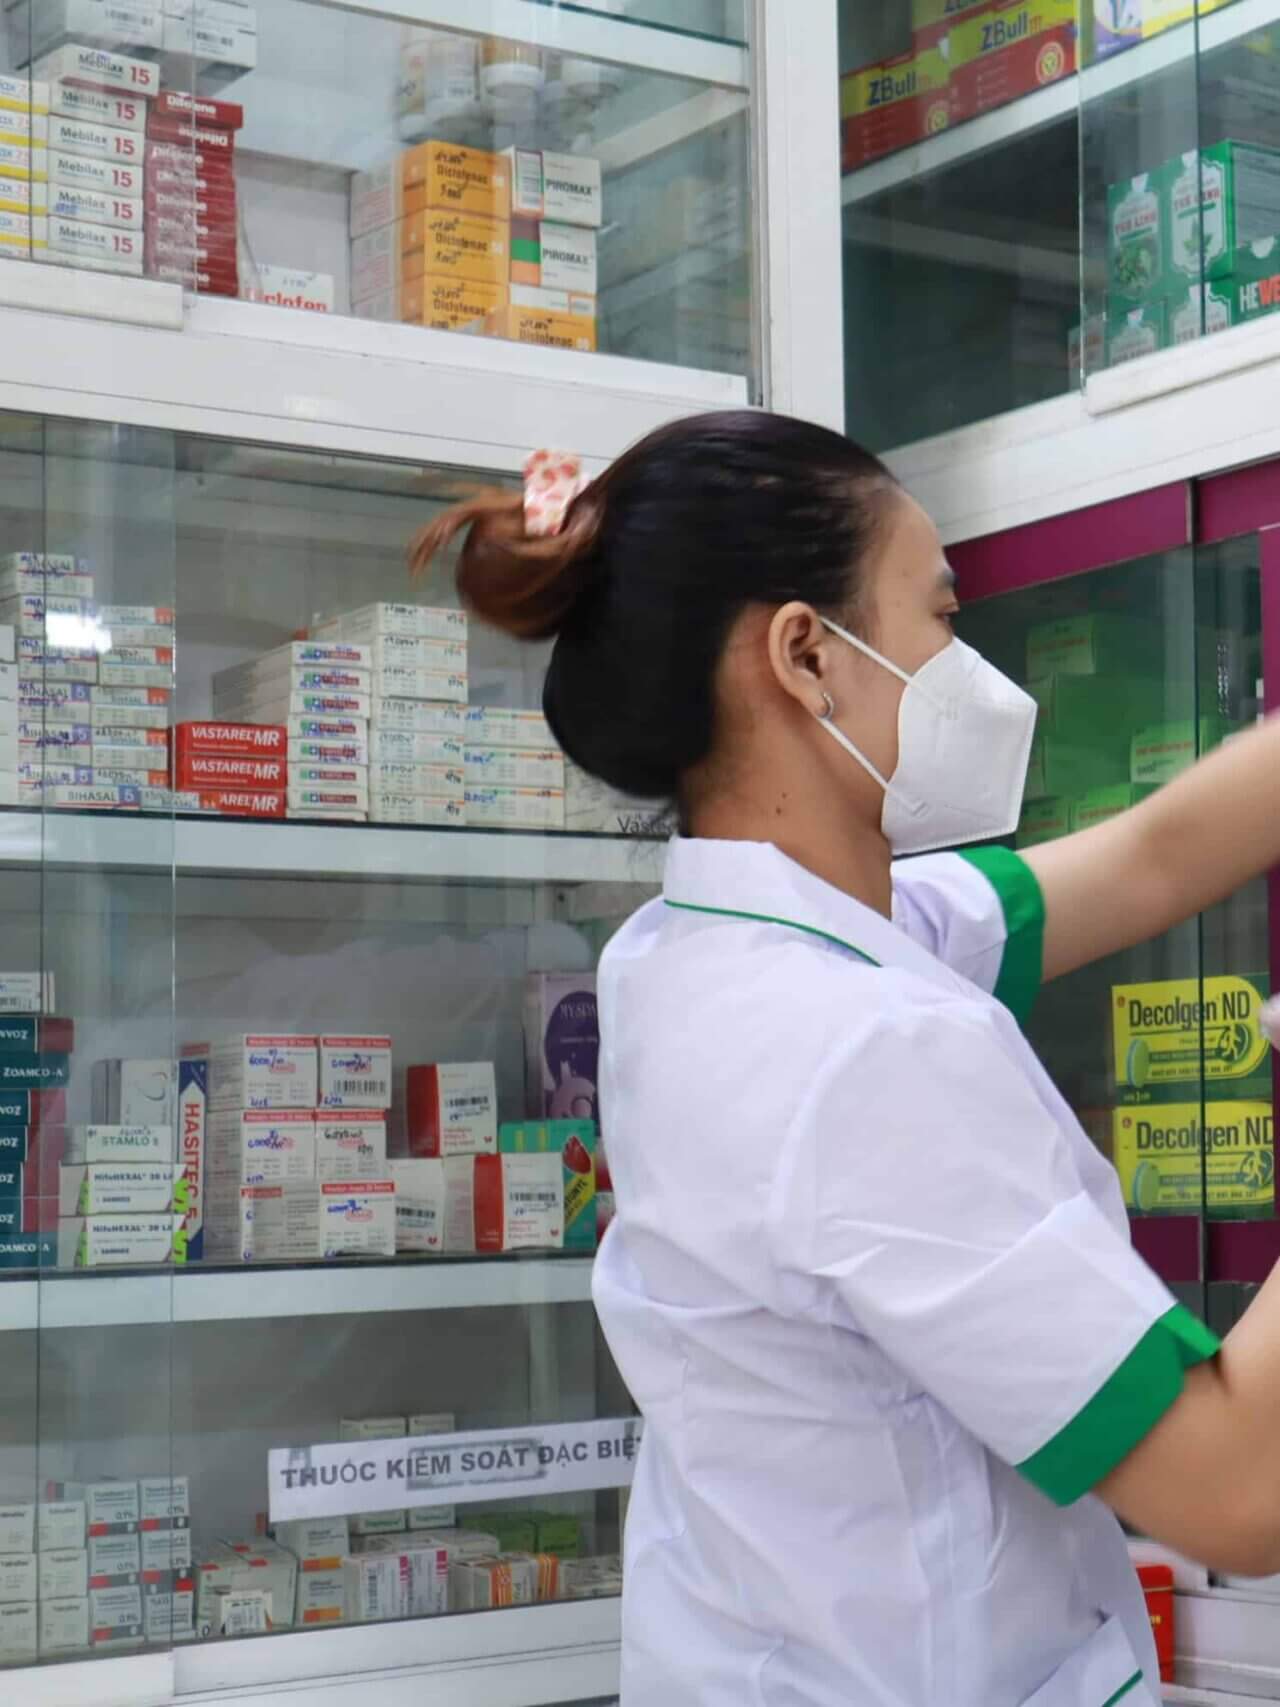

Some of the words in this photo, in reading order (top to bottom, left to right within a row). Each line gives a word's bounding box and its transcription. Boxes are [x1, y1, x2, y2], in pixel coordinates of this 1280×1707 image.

[130, 66, 151, 86] 15
[869, 72, 918, 106] ZBull
[115, 101, 136, 121] 15
[114, 137, 135, 156] 15
[112, 169, 132, 189] 15
[112, 201, 133, 221] 15
[112, 235, 133, 254] 15
[192, 727, 251, 742] VASTAREL
[254, 730, 280, 747] MR
[192, 759, 251, 775] VASTAREL
[254, 763, 280, 780] MR
[252, 796, 279, 813] MR
[1129, 996, 1217, 1029] Decolgen
[1222, 990, 1250, 1020] ND
[1136, 1118, 1239, 1152] Decolgen
[184, 1103, 200, 1198] HASITEC
[461, 1442, 530, 1472] SOÁT
